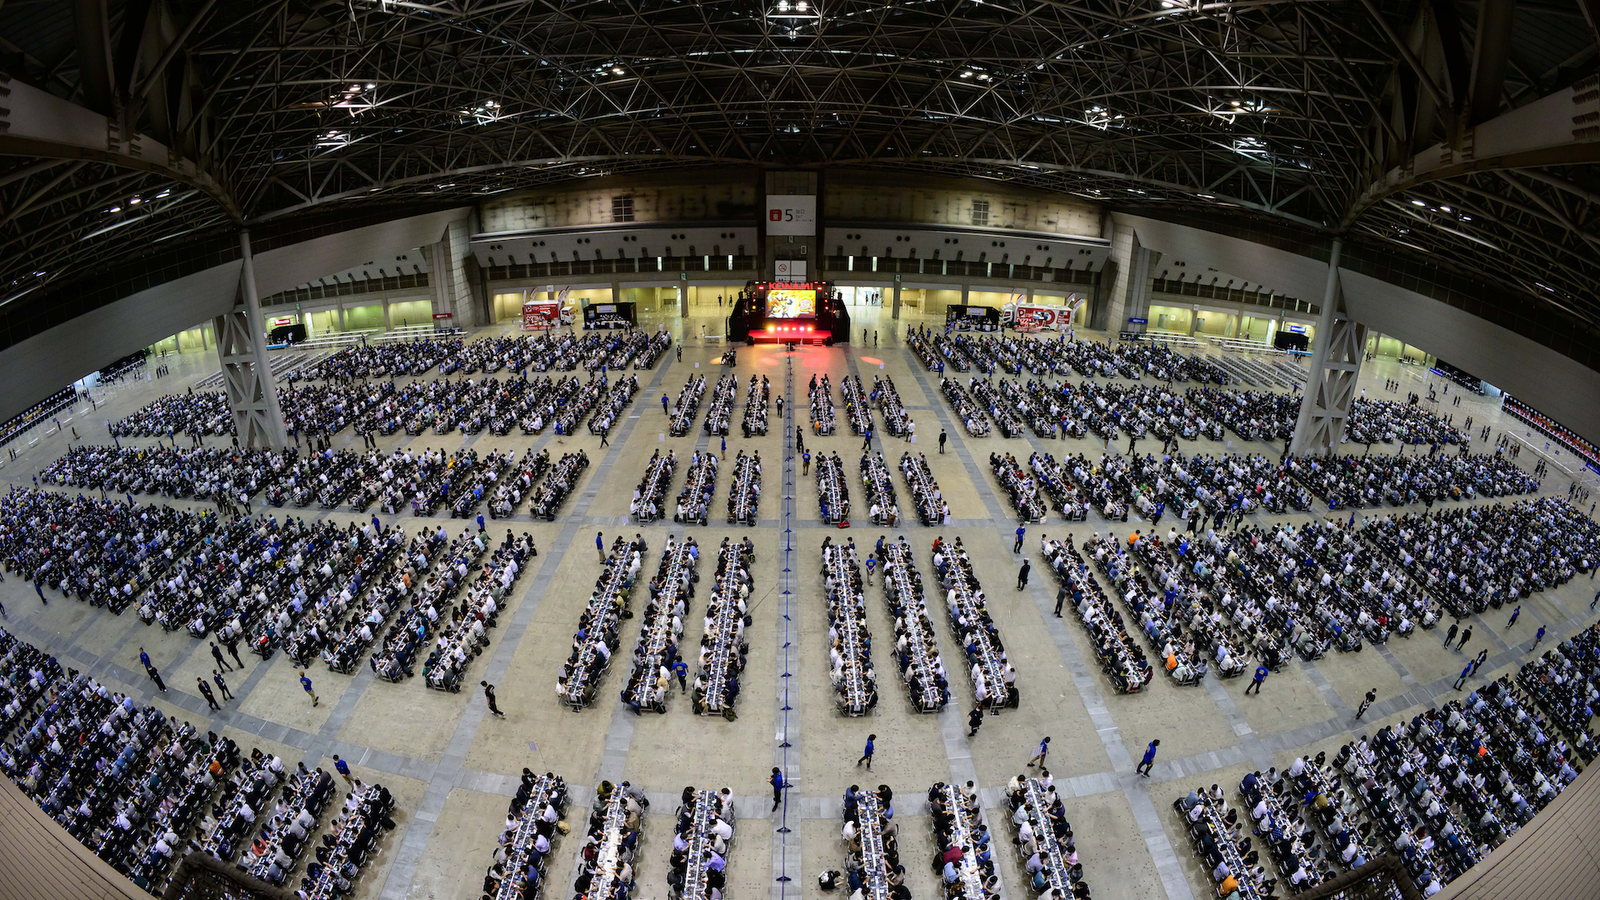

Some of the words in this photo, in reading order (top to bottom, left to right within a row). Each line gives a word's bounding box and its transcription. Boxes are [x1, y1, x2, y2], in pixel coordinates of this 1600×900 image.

[772, 213, 779, 221] 東
[785, 208, 793, 222] 5
[768, 281, 814, 290] KONAMI
